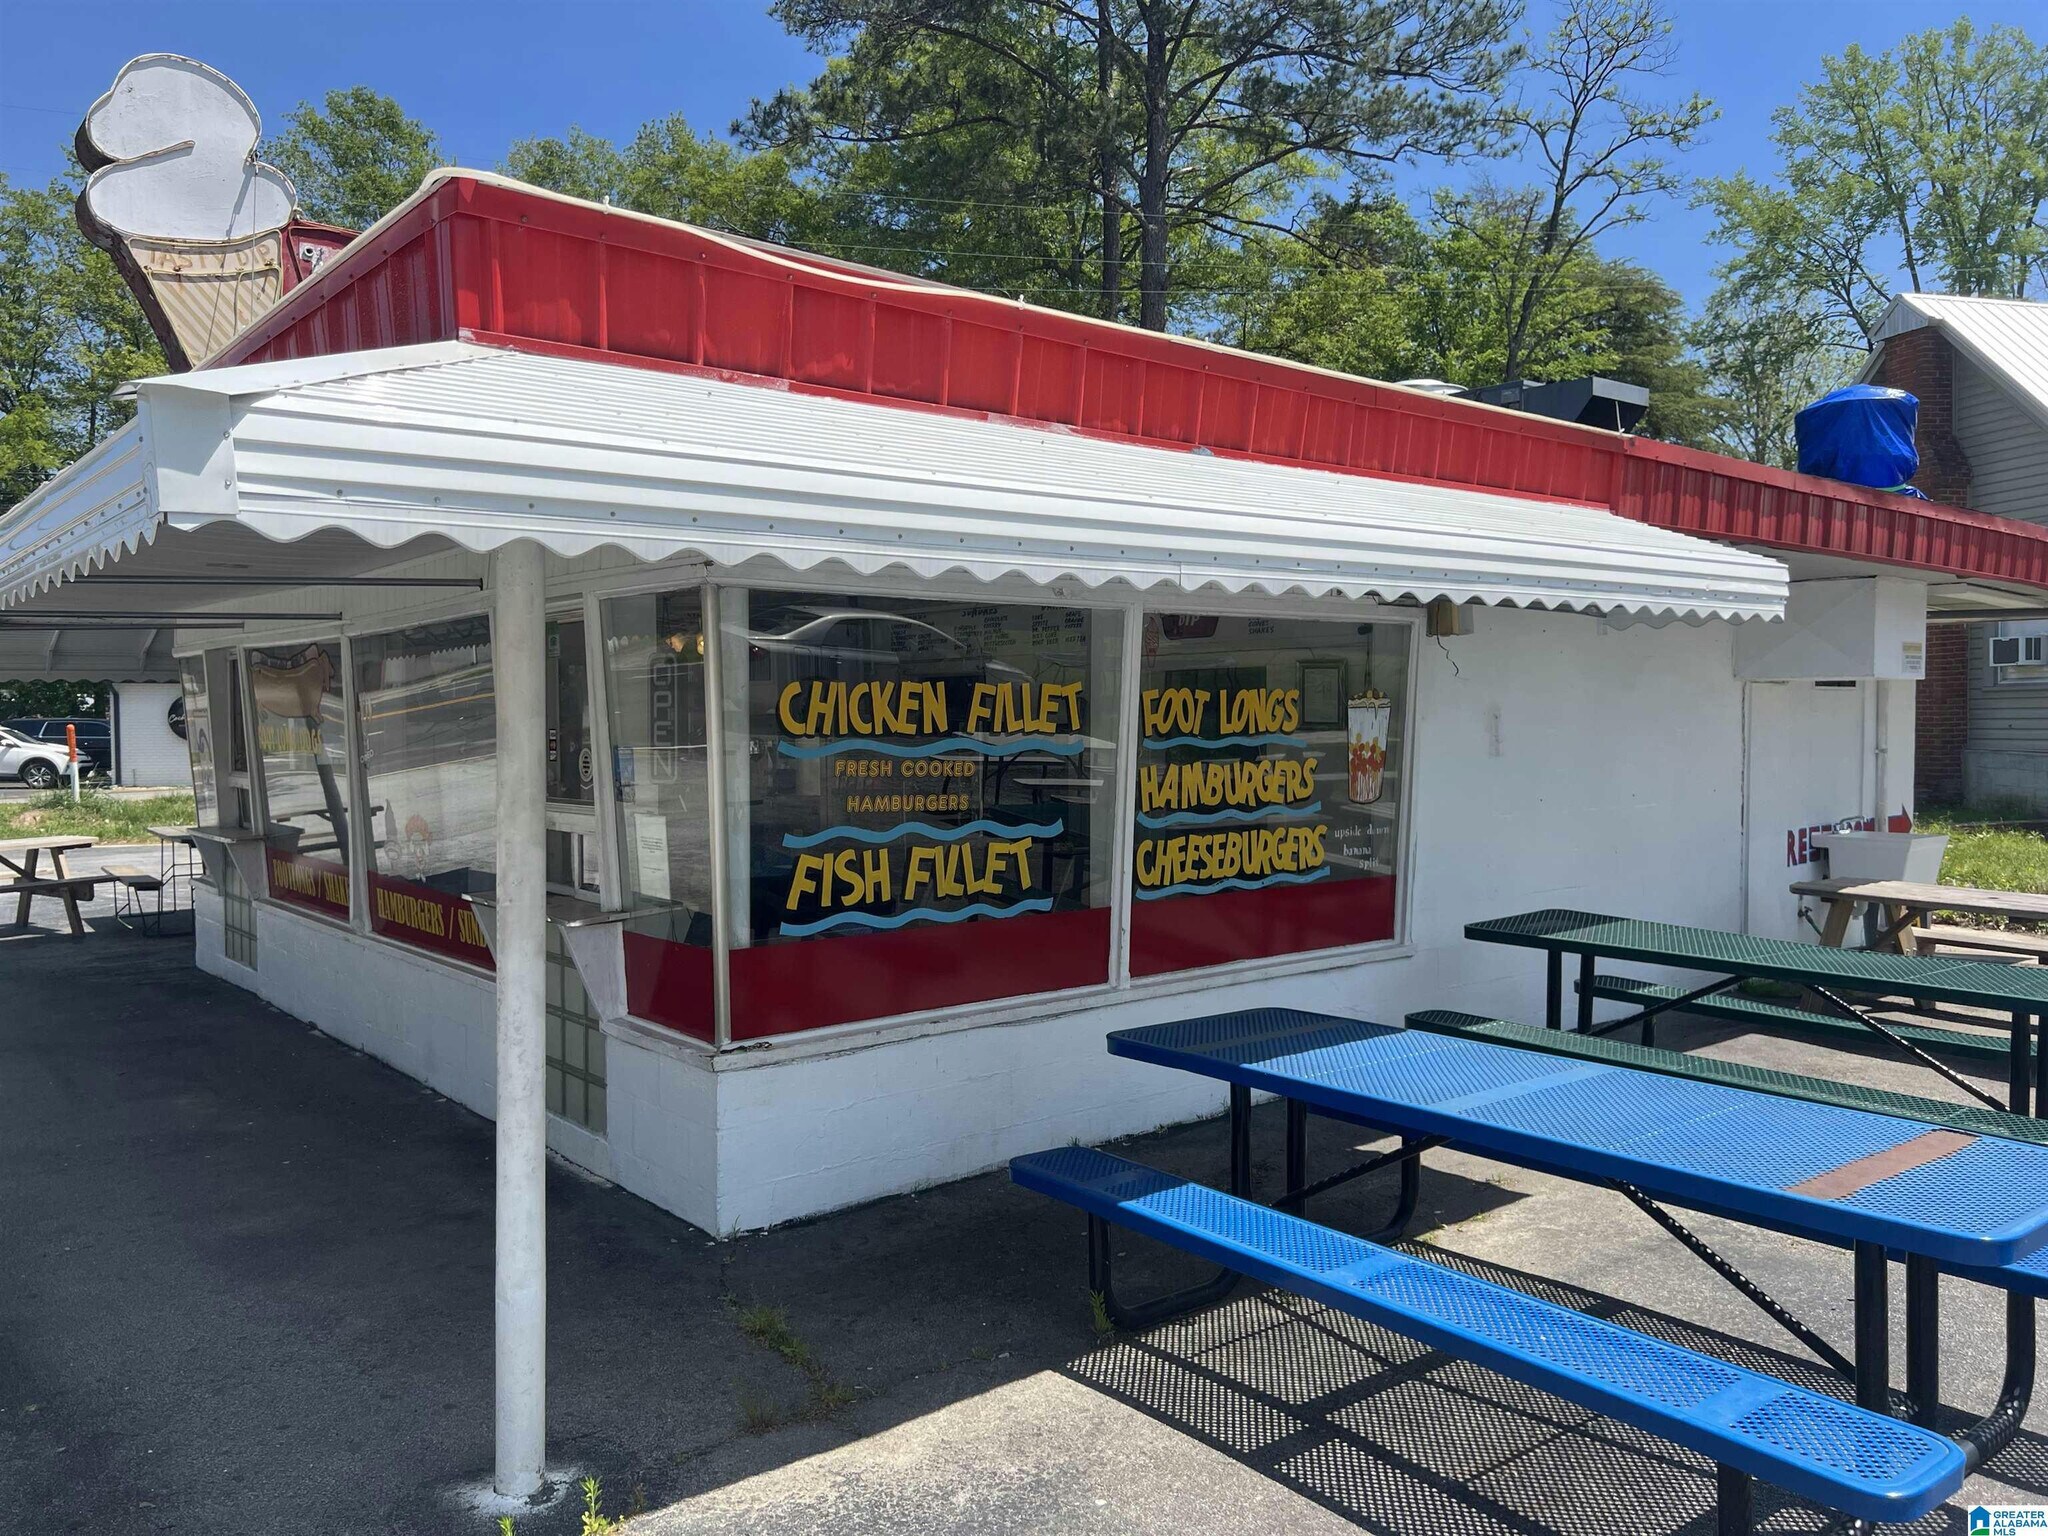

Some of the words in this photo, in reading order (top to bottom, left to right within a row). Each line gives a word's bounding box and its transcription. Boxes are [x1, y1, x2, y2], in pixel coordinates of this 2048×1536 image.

[653, 664, 673, 778] OPEN
[777, 680, 948, 737] CHICKEN
[966, 680, 1083, 734] FILLET
[1141, 687, 1211, 737] FOOT
[1219, 687, 1300, 735] LONGS
[834, 759, 892, 777] FRESH
[900, 759, 976, 778] COOKED
[1139, 756, 1319, 813] HAMBURGERS
[846, 794, 969, 813] HAMBURGERS
[1366, 823, 1390, 835] dwn
[785, 847, 891, 911] FISH
[904, 837, 1033, 899] FILLET
[1136, 823, 1328, 886] CHEESEBURGERS
[1359, 856, 1379, 870] split
[376, 887, 445, 937] HAMBURGERS
